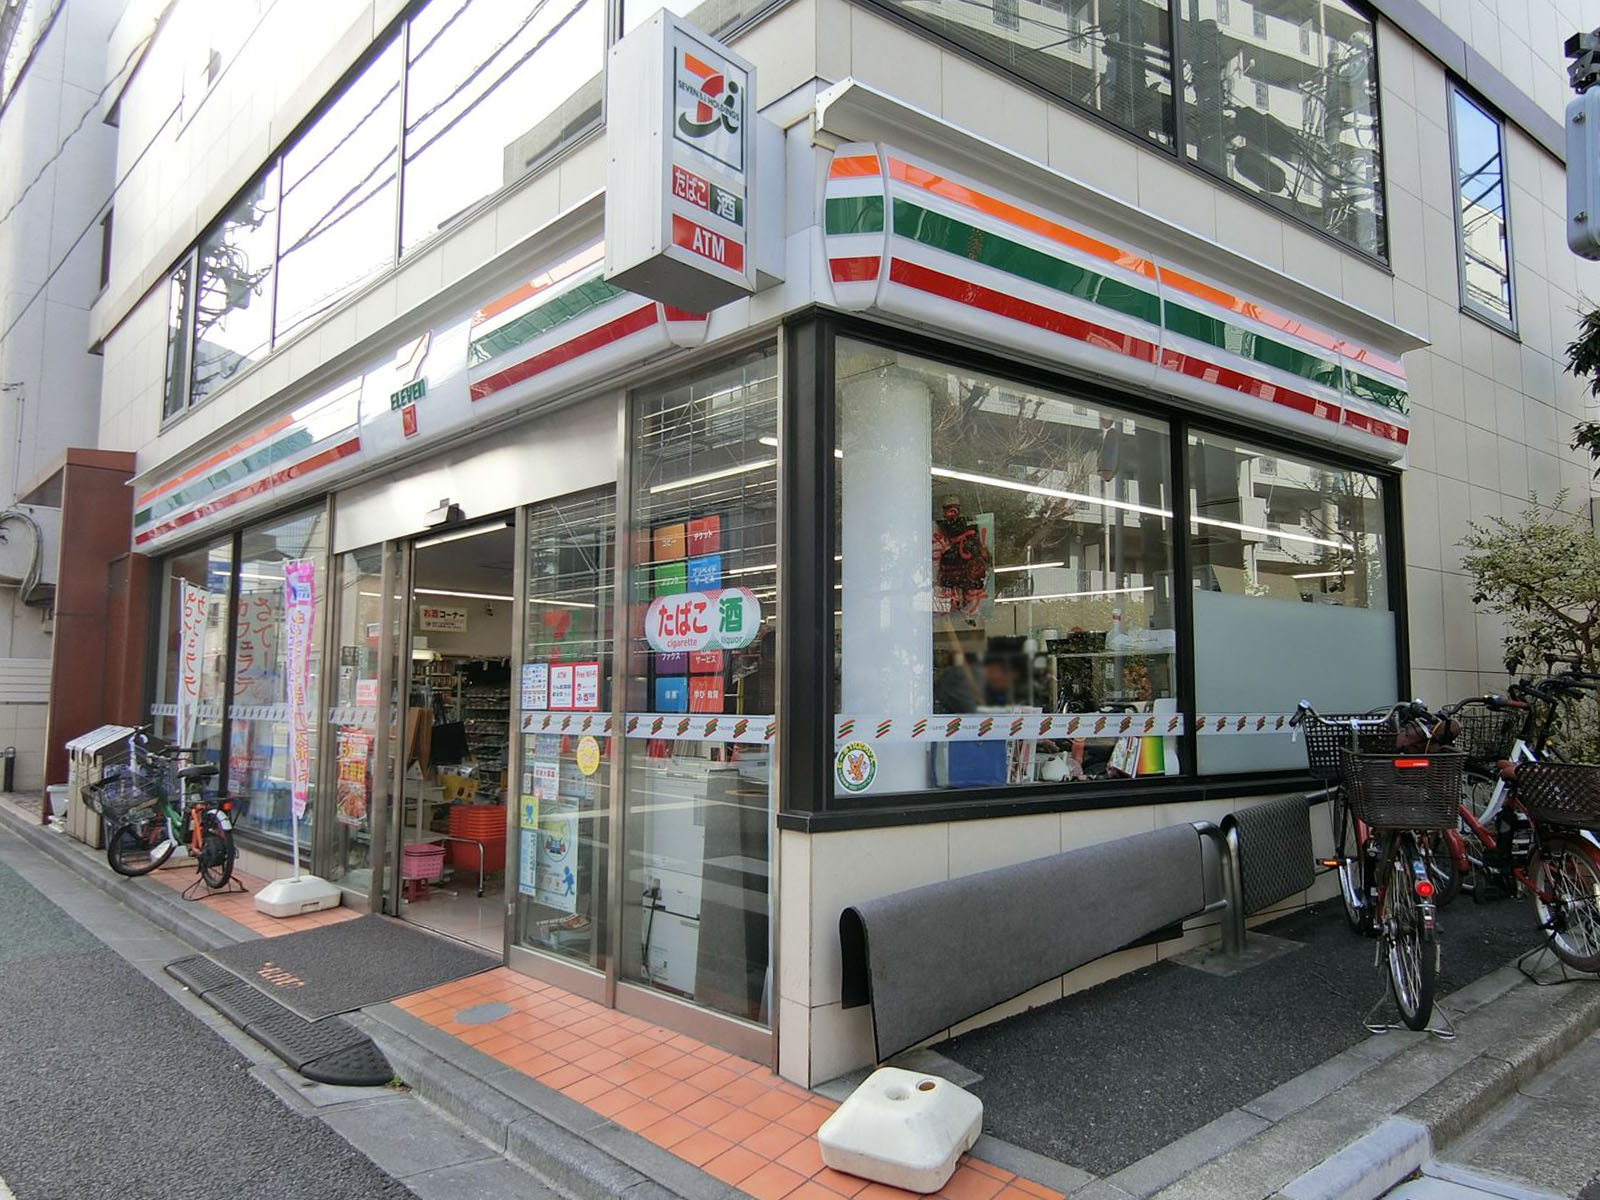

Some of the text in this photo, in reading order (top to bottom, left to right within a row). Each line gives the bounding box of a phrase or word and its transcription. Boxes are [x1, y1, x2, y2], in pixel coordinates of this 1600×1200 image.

[707, 97, 740, 121] HOLDINGS
[675, 170, 737, 221] たばこ 酒
[692, 227, 725, 263] ATM
[658, 597, 743, 638] たばこ 酒
[666, 638, 698, 653] cigarette
[695, 655, 717, 665] サービス
